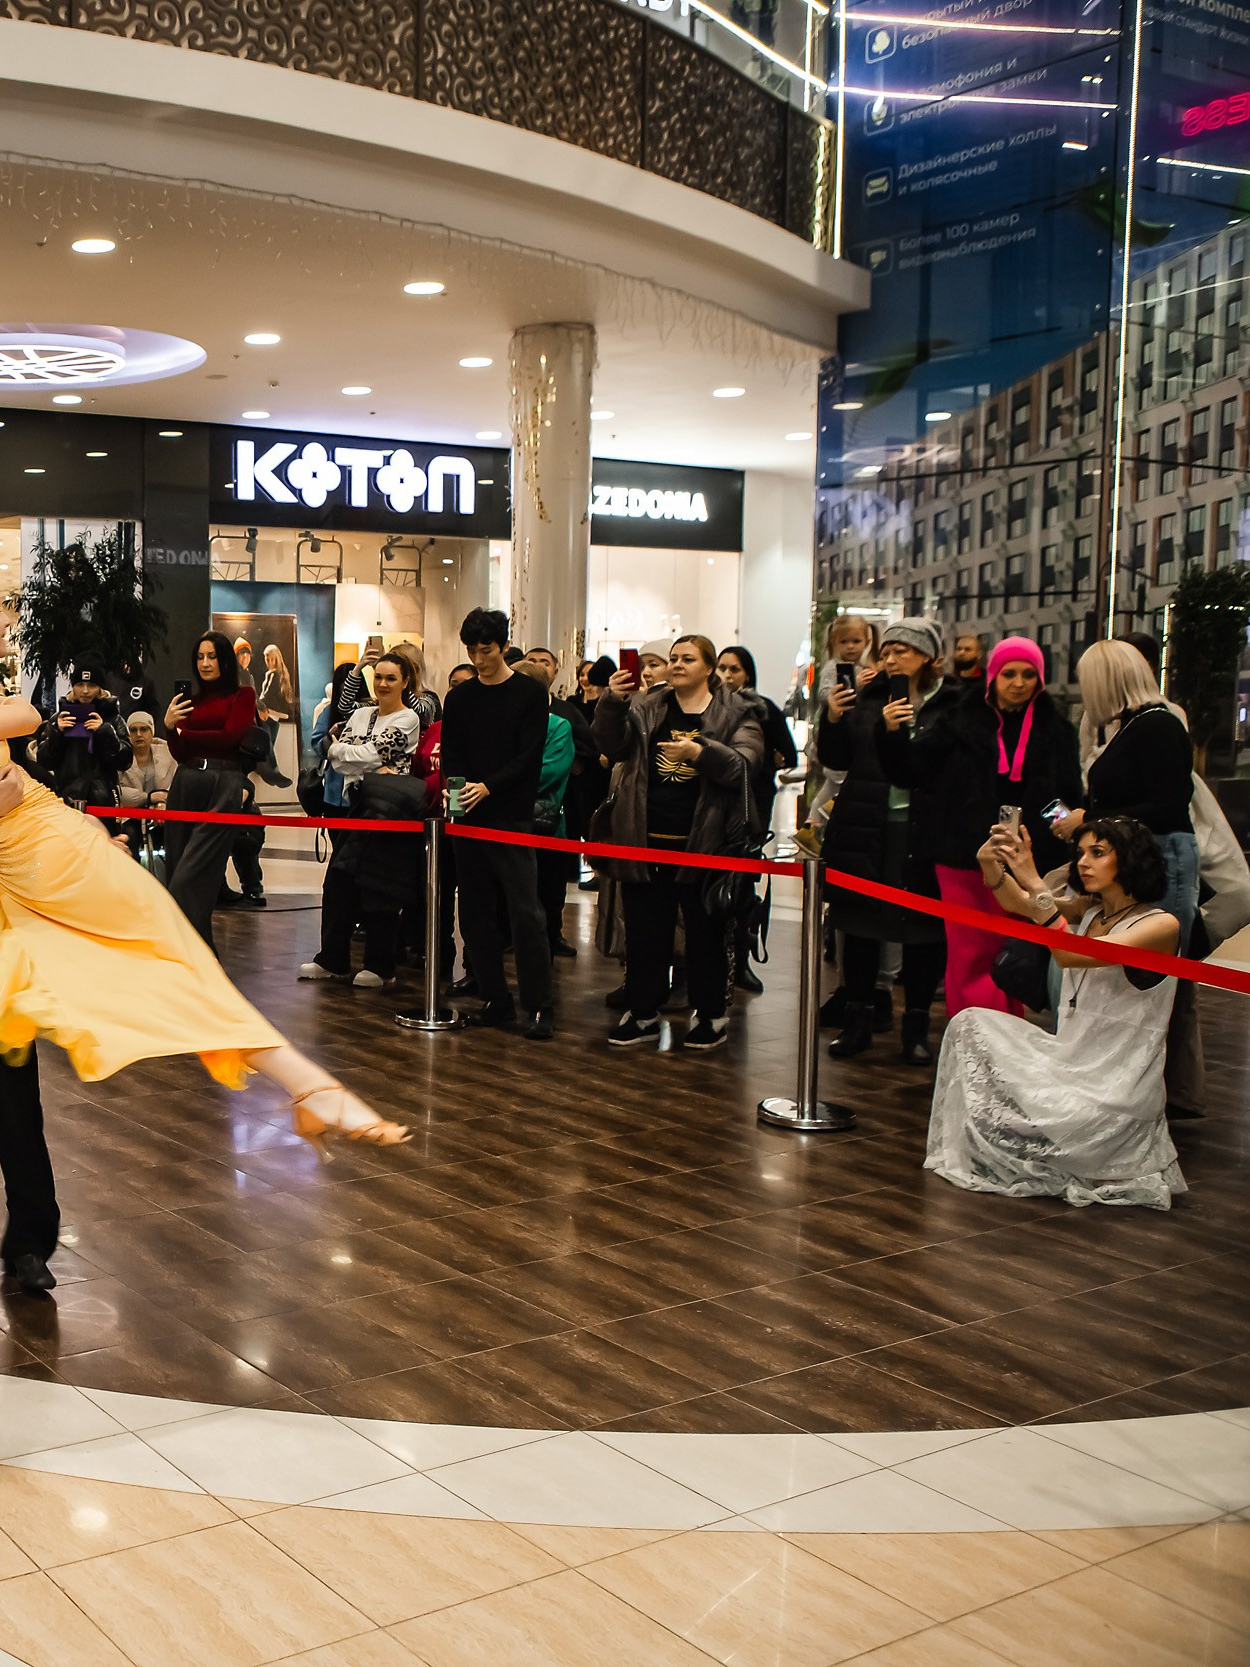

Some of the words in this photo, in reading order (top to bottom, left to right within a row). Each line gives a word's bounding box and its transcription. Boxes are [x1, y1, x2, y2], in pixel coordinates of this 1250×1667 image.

[1000, 69, 1048, 92] замки
[897, 139, 1005, 179] Дизайнерские
[1009, 124, 1057, 147] холлы
[897, 183, 908, 196] и
[910, 160, 998, 191] колясочные
[898, 227, 1036, 269] видеонаблюдения
[899, 230, 941, 251] Более
[945, 223, 970, 241] 100
[973, 212, 1020, 233] камер
[592, 485, 709, 522] ZEDONIA
